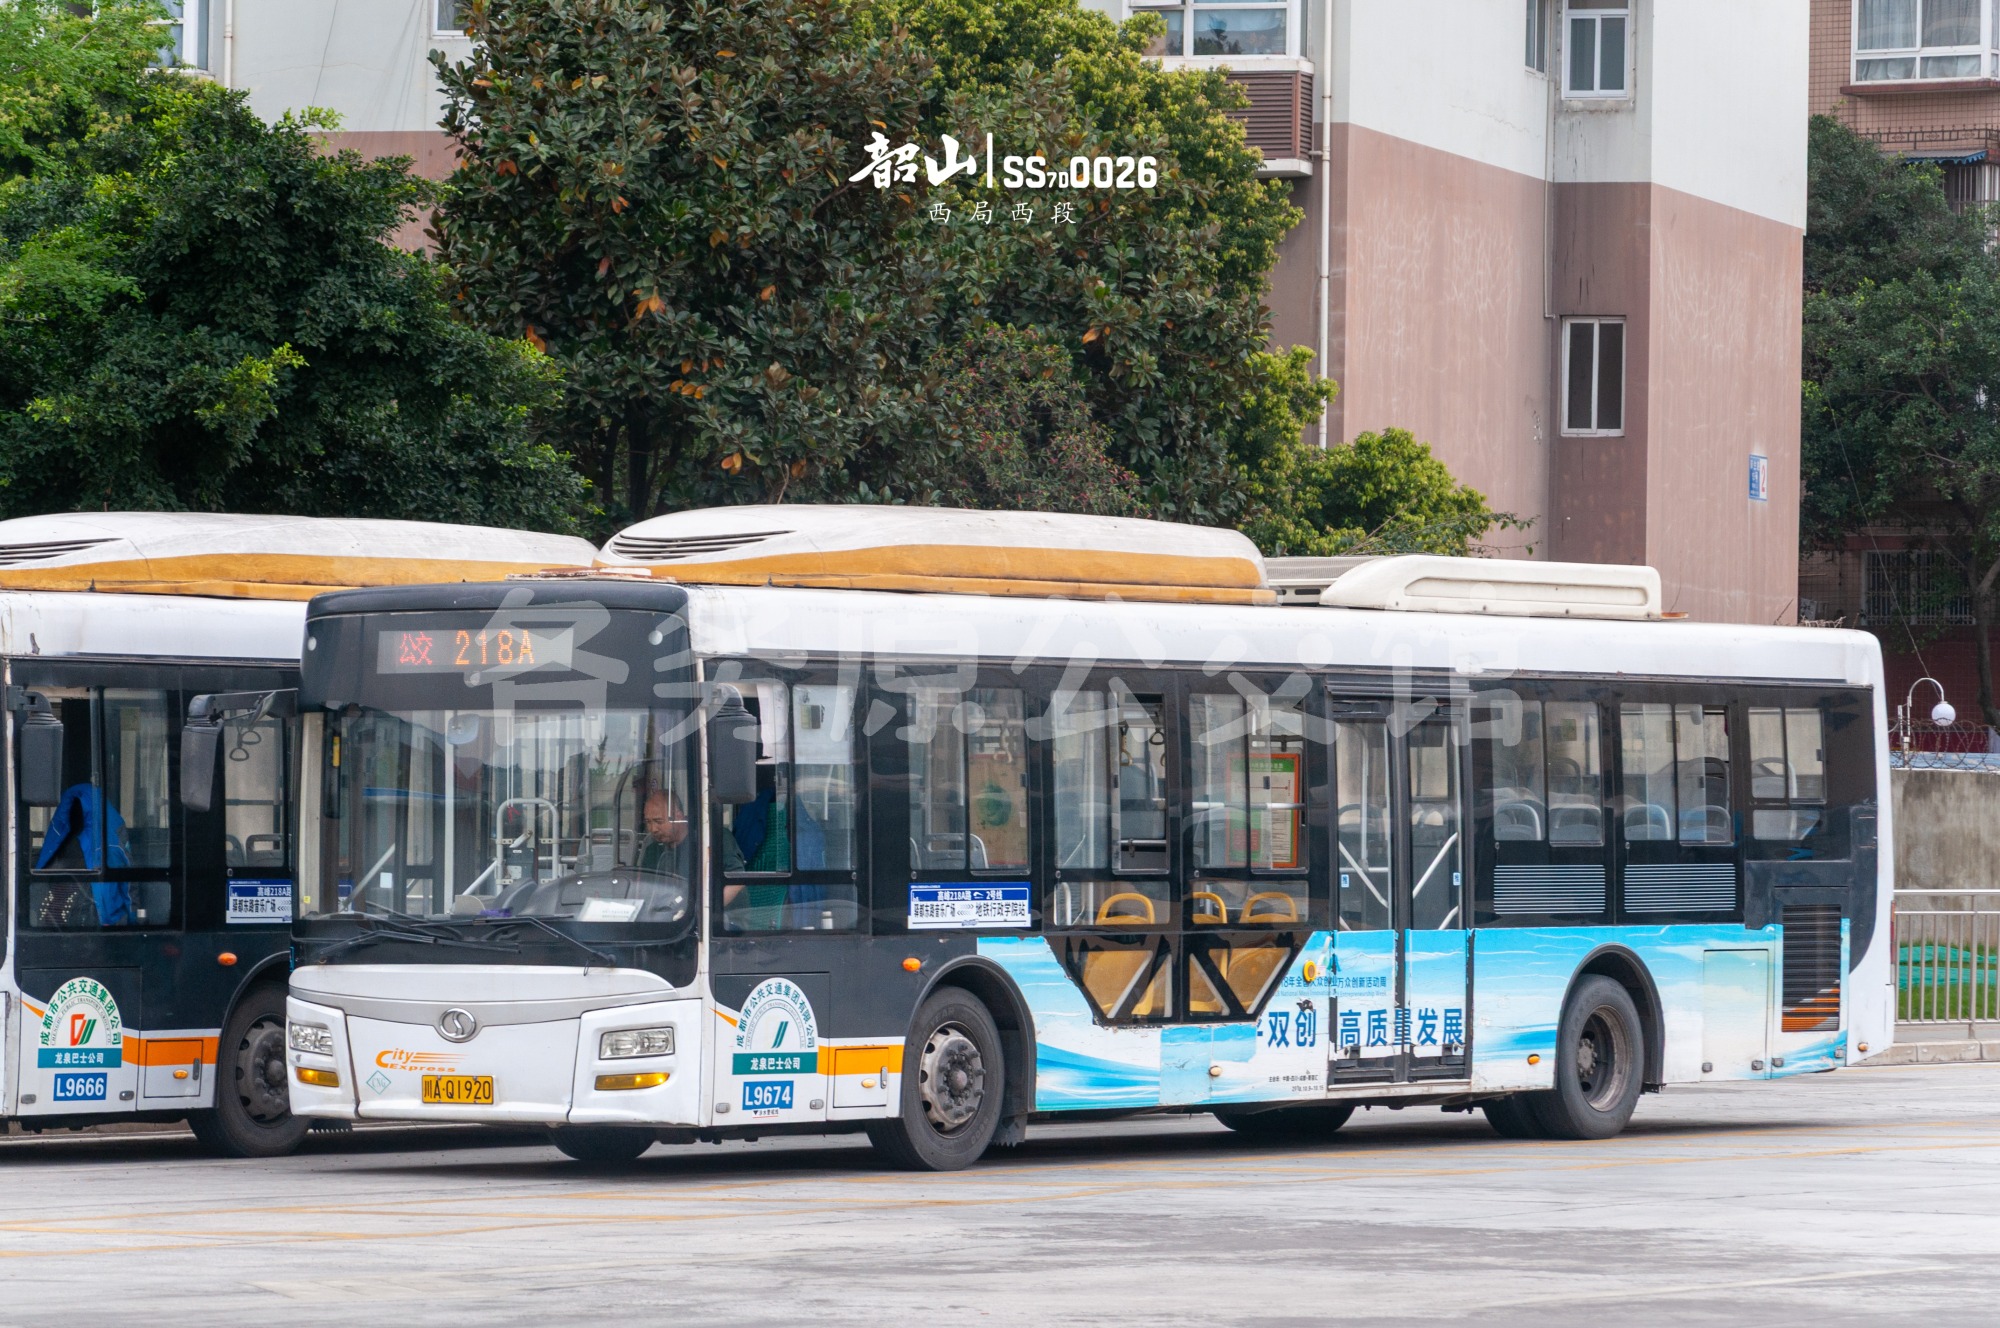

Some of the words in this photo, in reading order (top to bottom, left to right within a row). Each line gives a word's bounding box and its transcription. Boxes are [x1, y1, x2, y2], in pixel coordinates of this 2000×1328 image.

[454, 629, 535, 665] 218A
[975, 902, 1026, 917] 地铁行政学院站
[40, 979, 121, 1046] 成都市公共交通集团公司
[736, 982, 815, 1048] 成都市公共交通集团有限公司
[1257, 1008, 1317, 1048] 双创
[1339, 1007, 1464, 1048] 高质量发展
[54, 1052, 104, 1064] 龙泉巴士公司
[375, 1047, 414, 1069] City
[750, 1057, 801, 1070] 龙泉巴士公司
[56, 1077, 105, 1098] L9666
[371, 1077, 386, 1089] CNG
[744, 1085, 792, 1106] L9674
